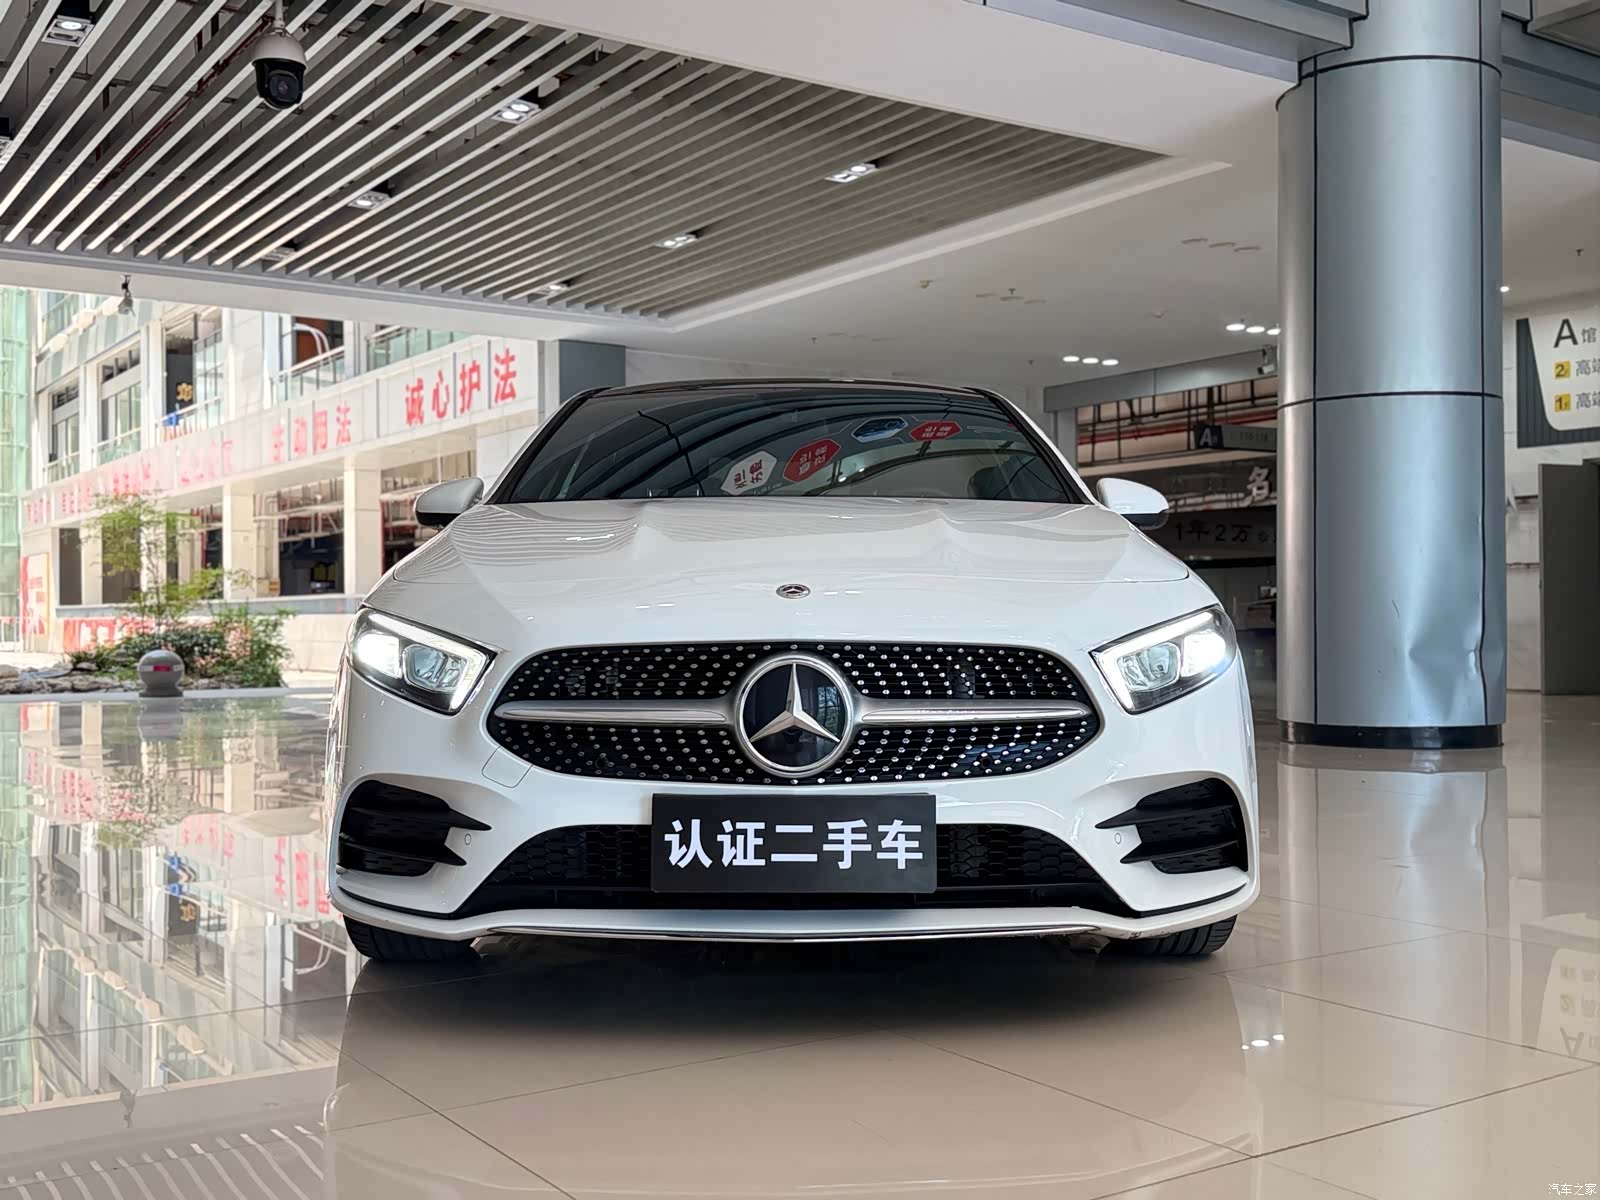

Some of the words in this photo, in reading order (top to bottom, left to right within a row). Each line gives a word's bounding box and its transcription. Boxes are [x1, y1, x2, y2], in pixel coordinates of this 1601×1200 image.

[405, 347, 517, 426] 诚心护法
[664, 818, 924, 870] 认证二手车
